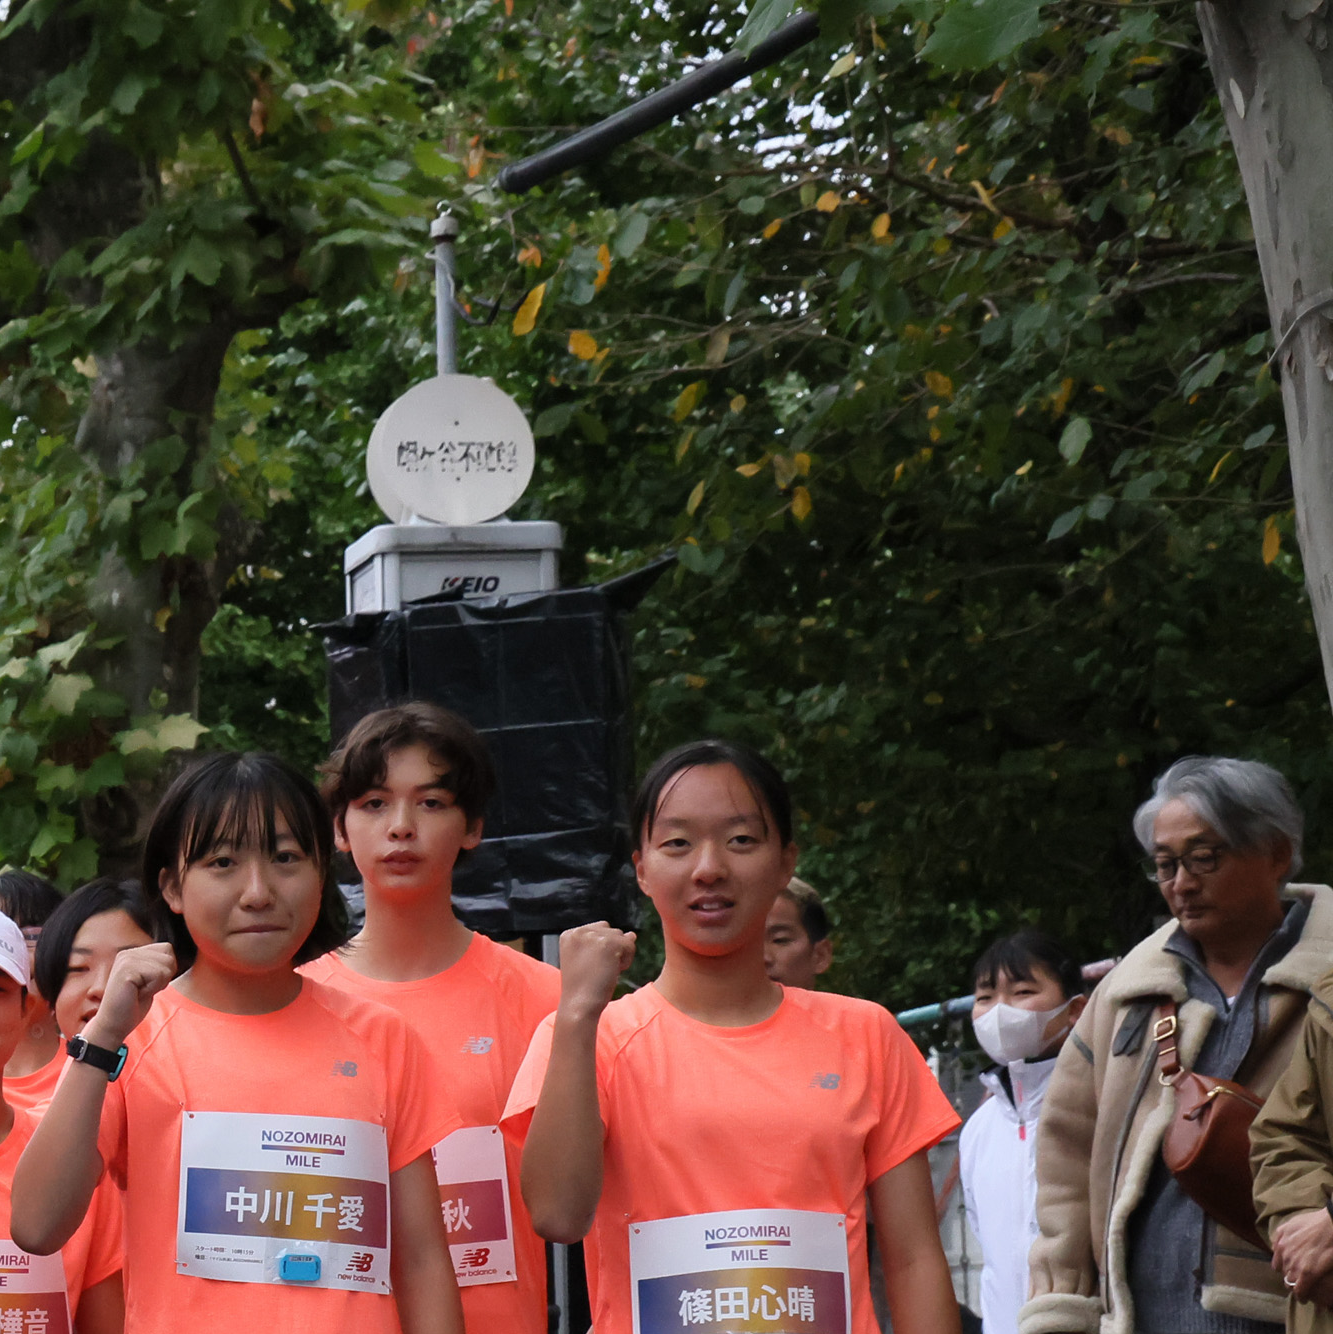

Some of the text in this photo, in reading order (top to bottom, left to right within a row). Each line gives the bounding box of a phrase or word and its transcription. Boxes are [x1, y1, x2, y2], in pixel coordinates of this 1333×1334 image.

[442, 576, 500, 593] KEIO
[262, 1130, 346, 1147] NOZOMIRAI
[286, 1155, 321, 1168] MILE
[225, 1186, 365, 1233] 中川 千愛
[441, 1198, 473, 1233] 秋
[704, 1226, 791, 1241] NOZOMIRAI
[731, 1249, 769, 1261] MILE
[353, 1275, 376, 1284] balance
[468, 1269, 497, 1277] balance
[678, 1284, 815, 1327] 篠田心晴
